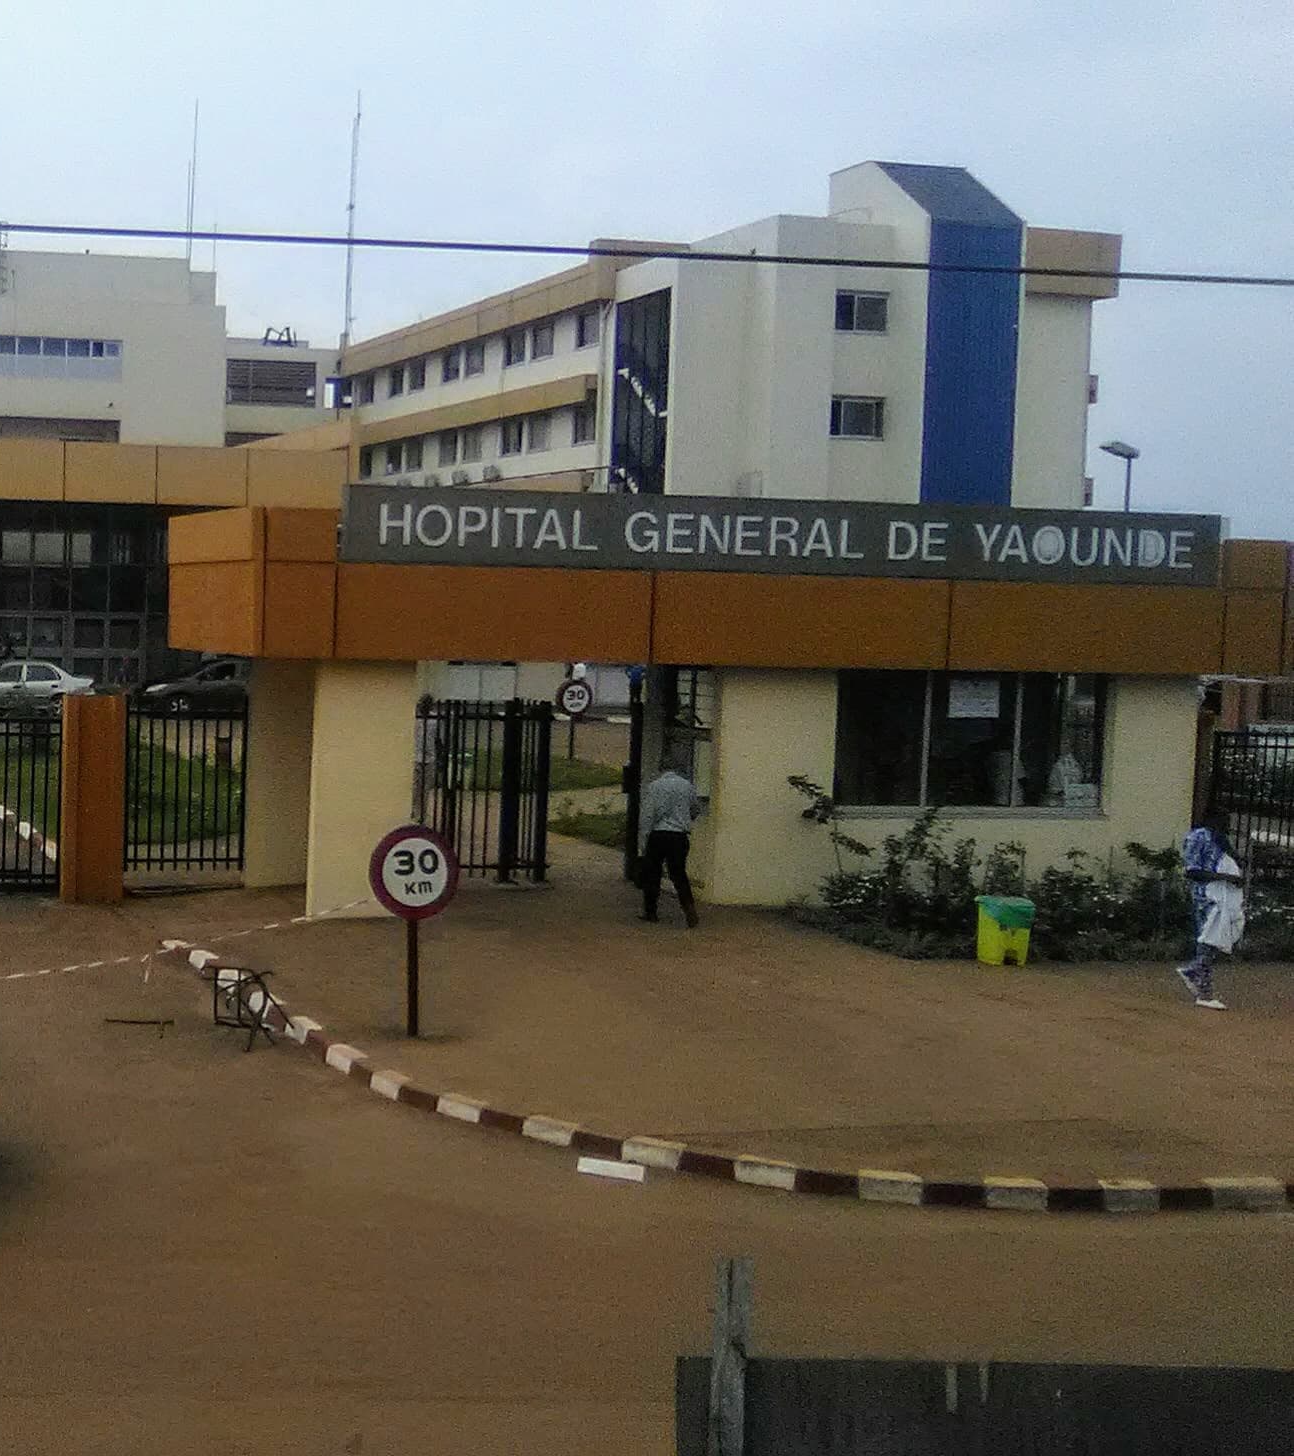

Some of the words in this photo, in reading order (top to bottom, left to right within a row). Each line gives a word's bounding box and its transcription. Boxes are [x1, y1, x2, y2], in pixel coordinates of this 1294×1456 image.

[378, 503, 598, 551] HOPITAL
[624, 511, 864, 559] GENERAL
[887, 520, 949, 562] DE
[975, 523, 1194, 569] YAOUNDE
[567, 690, 585, 700] 30
[393, 849, 439, 875] 30
